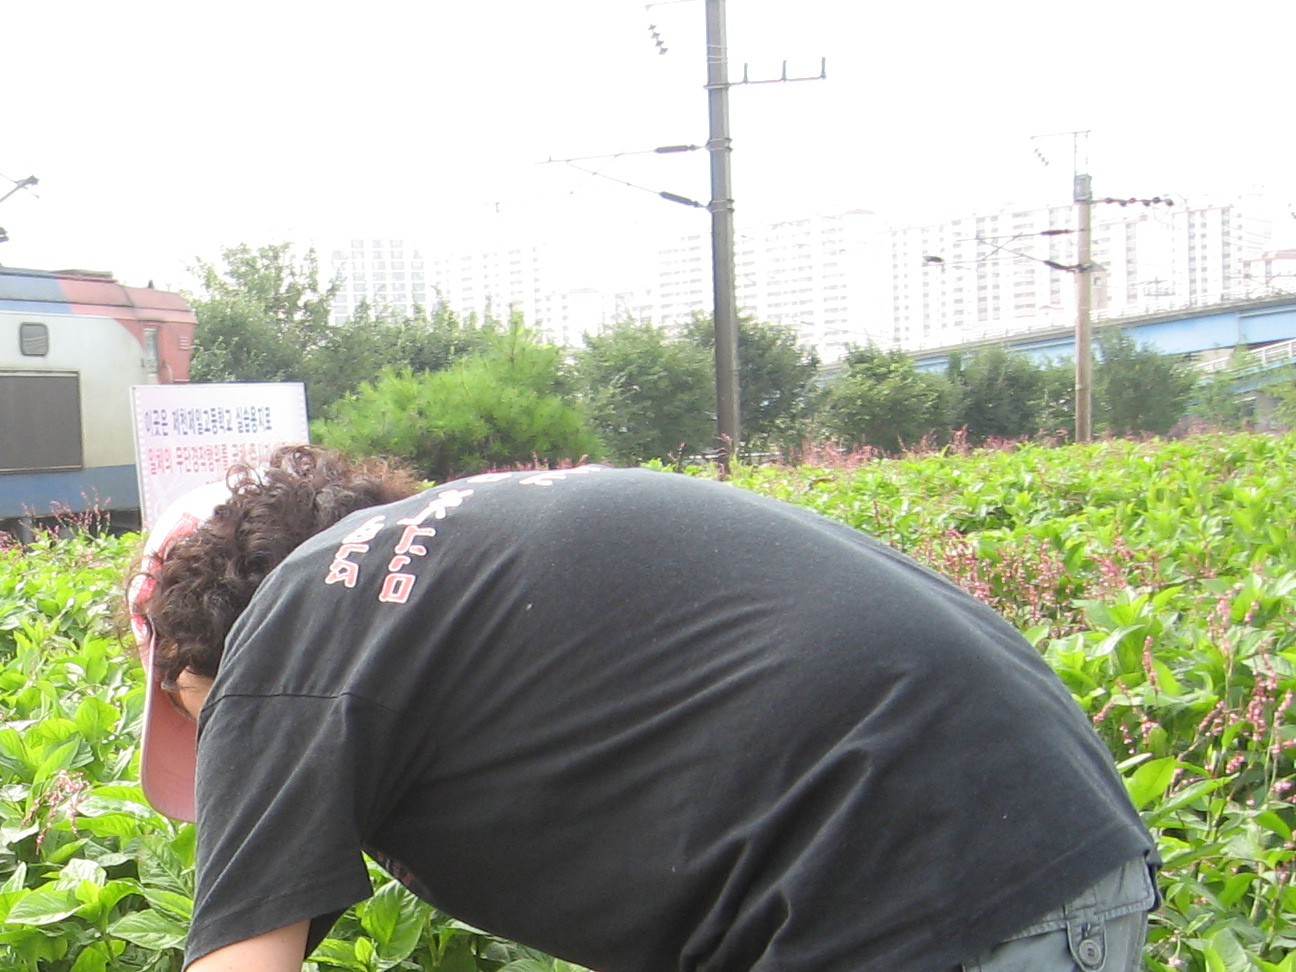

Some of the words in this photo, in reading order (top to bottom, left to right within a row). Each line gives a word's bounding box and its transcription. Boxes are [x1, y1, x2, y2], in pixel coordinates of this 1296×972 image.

[145, 409, 169, 436] 이곳은
[172, 407, 233, 436] 제천제일고등학교
[236, 406, 272, 434] 실습용지로
[149, 448, 174, 475] 일체의
